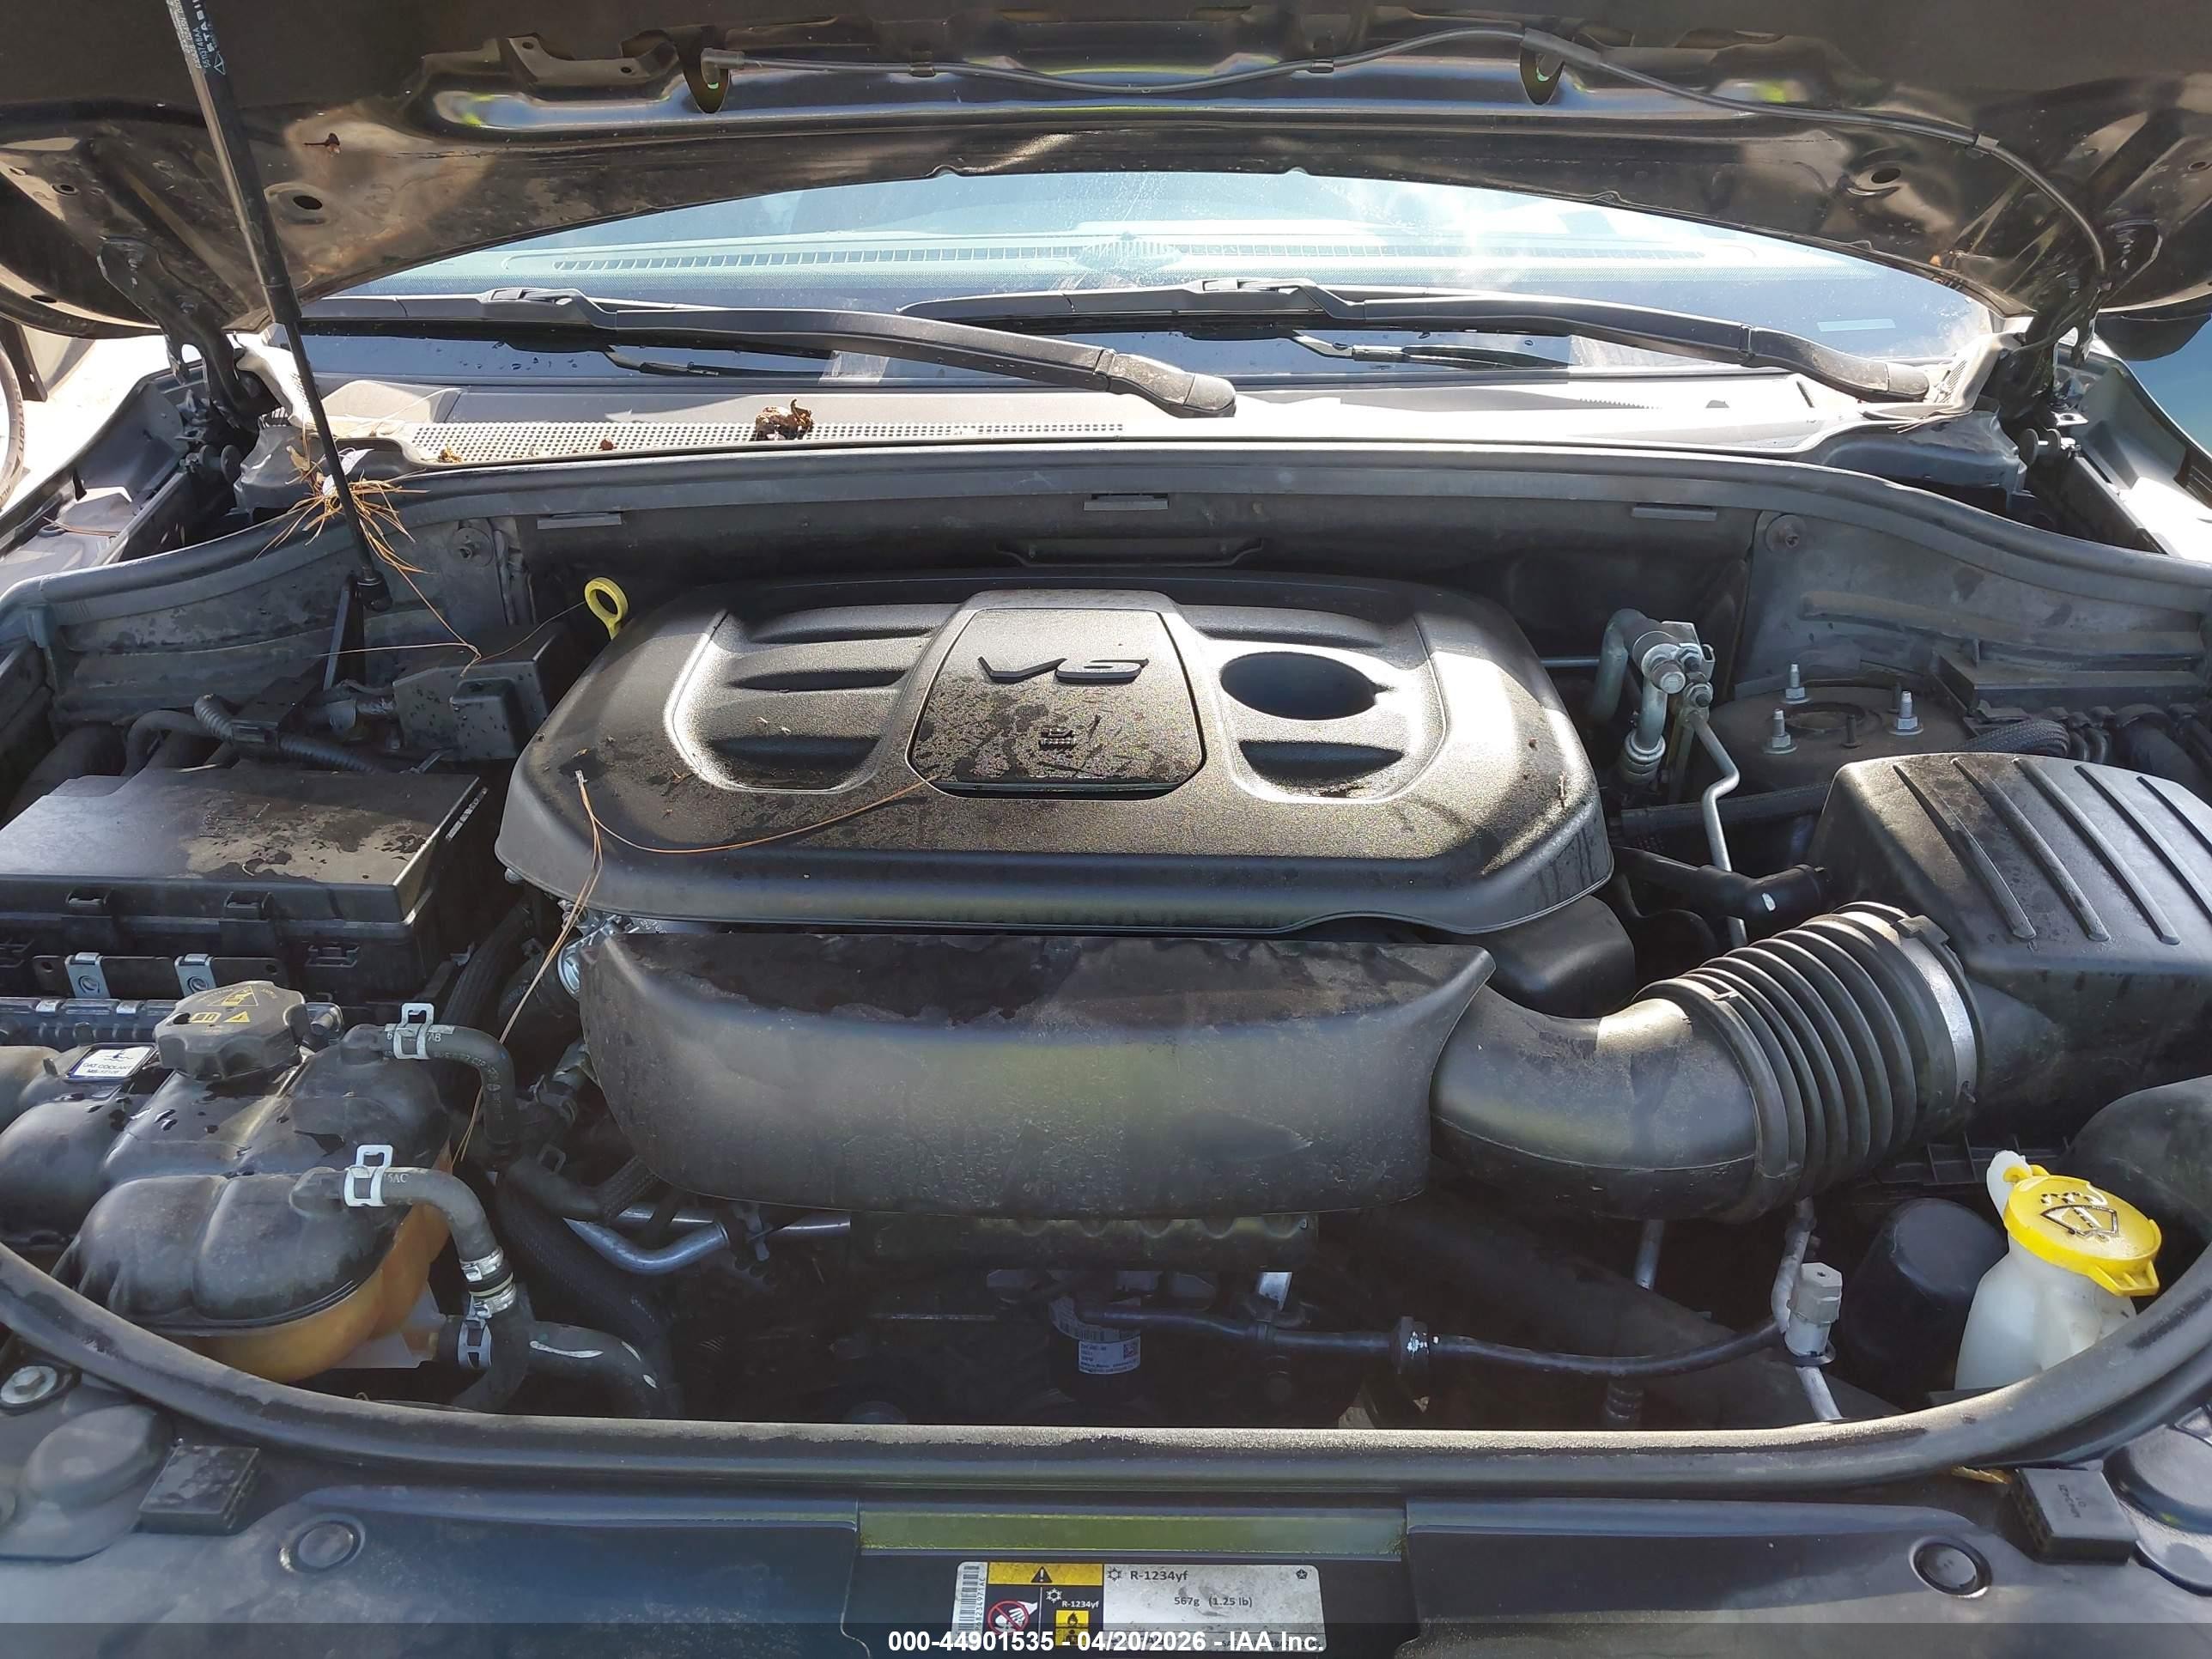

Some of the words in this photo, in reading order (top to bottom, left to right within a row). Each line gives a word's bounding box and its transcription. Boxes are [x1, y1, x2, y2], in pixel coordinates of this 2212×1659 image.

[977, 656, 1150, 684] V6
[1130, 1570, 1188, 1582] R-1234yf
[1061, 1601, 1100, 1609] R-1234yf
[1174, 1596, 1200, 1607] 567g
[1208, 1595, 1236, 1607] (1.25
[1238, 1595, 1254, 1607] lb)
